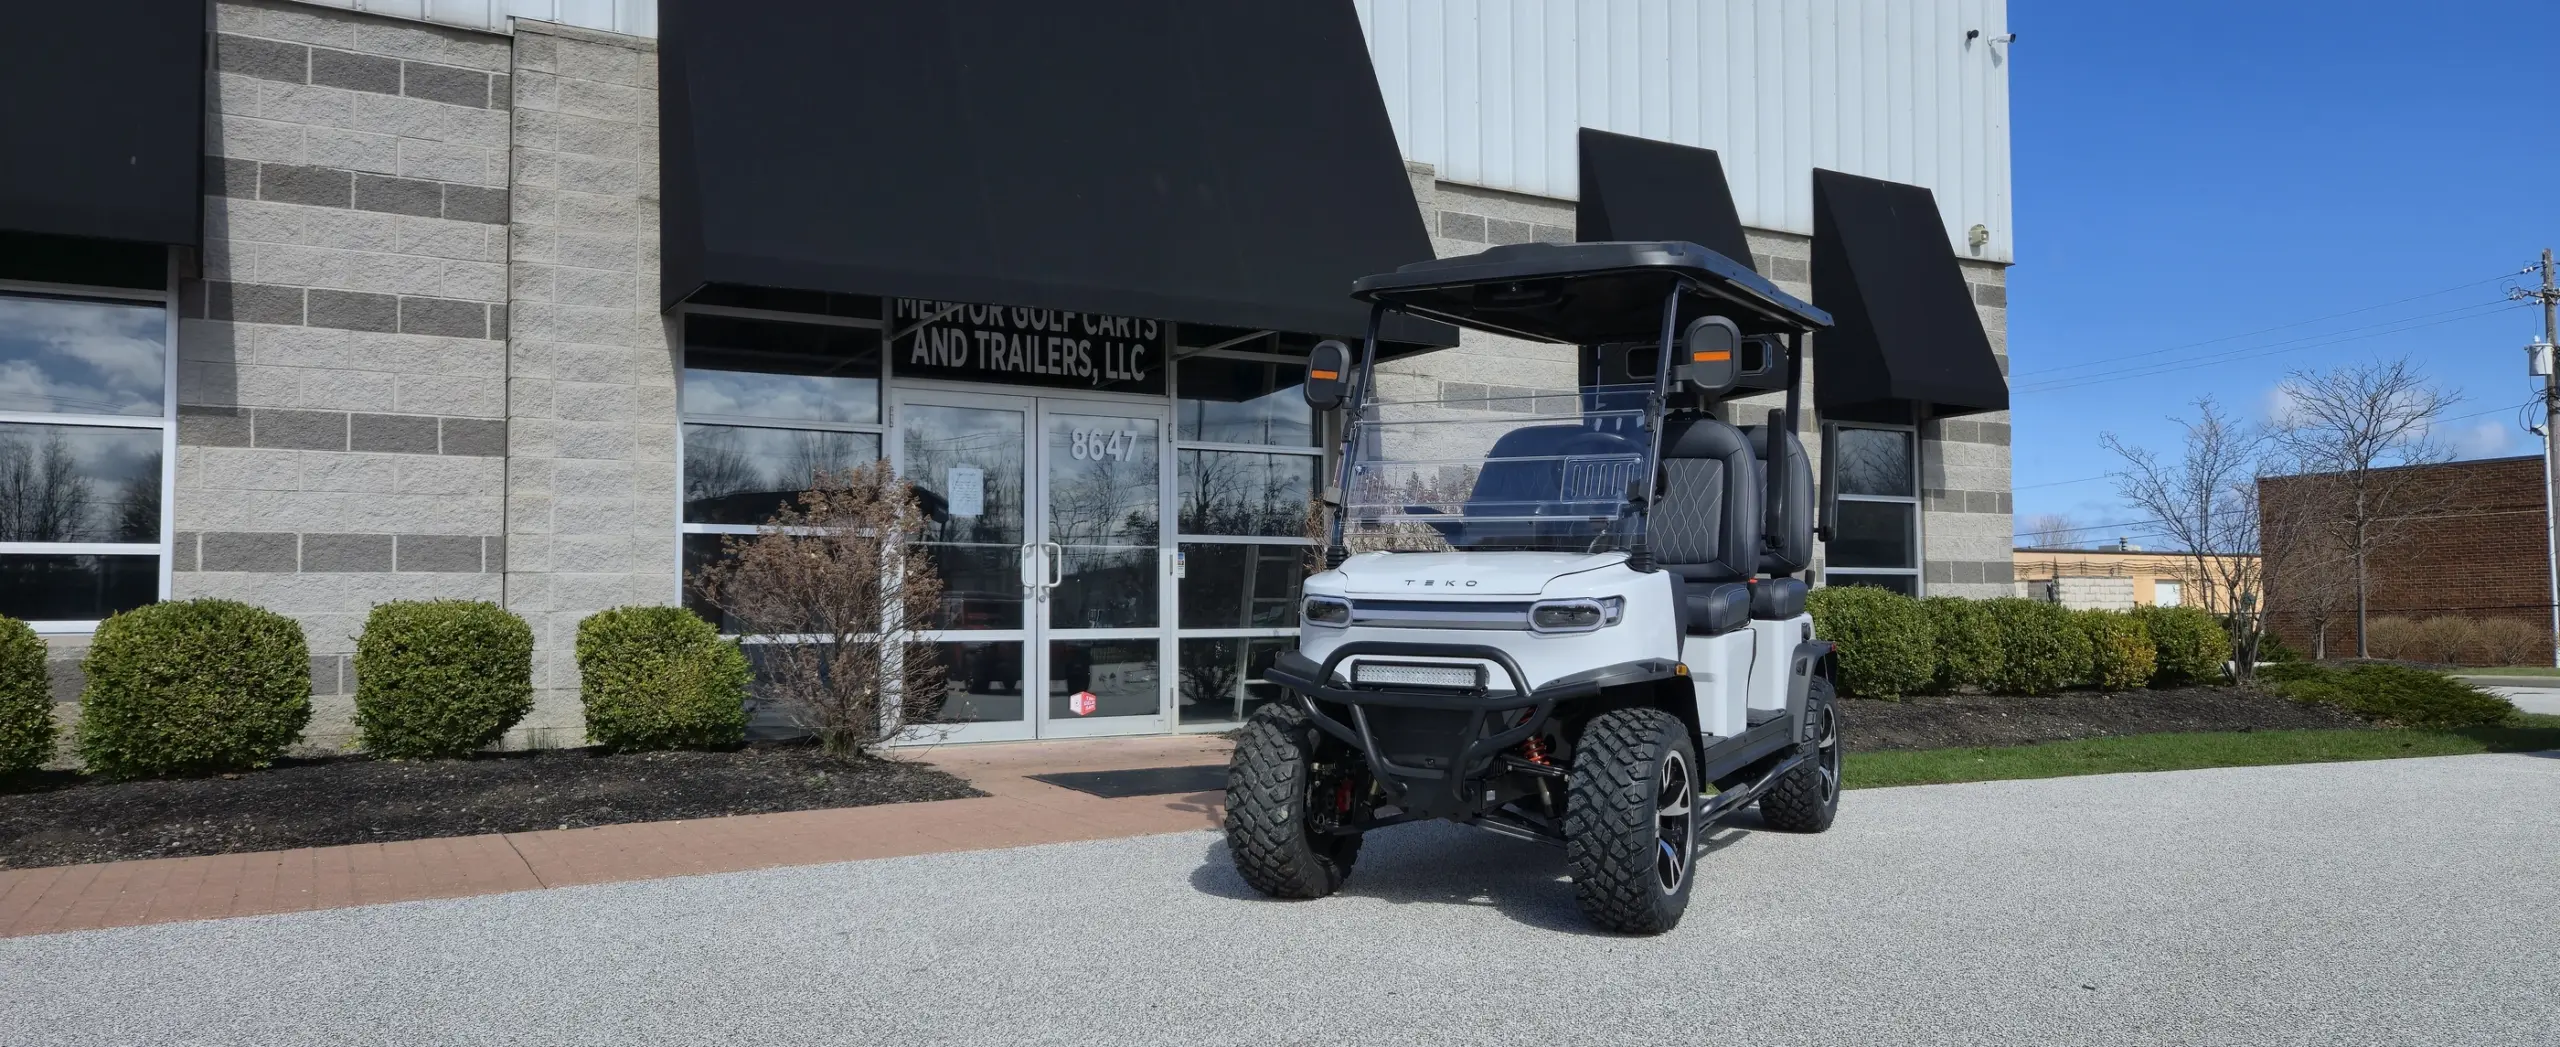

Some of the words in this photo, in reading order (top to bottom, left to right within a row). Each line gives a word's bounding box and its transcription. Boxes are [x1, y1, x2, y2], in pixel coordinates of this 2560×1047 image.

[1012, 307, 1075, 333] GOLF
[911, 326, 967, 367] AND
[975, 331, 1098, 385] TRAILERS,
[1105, 341, 1145, 381] LLC
[1071, 427, 1137, 462] 8647
[1405, 579, 1478, 587] TEKO
